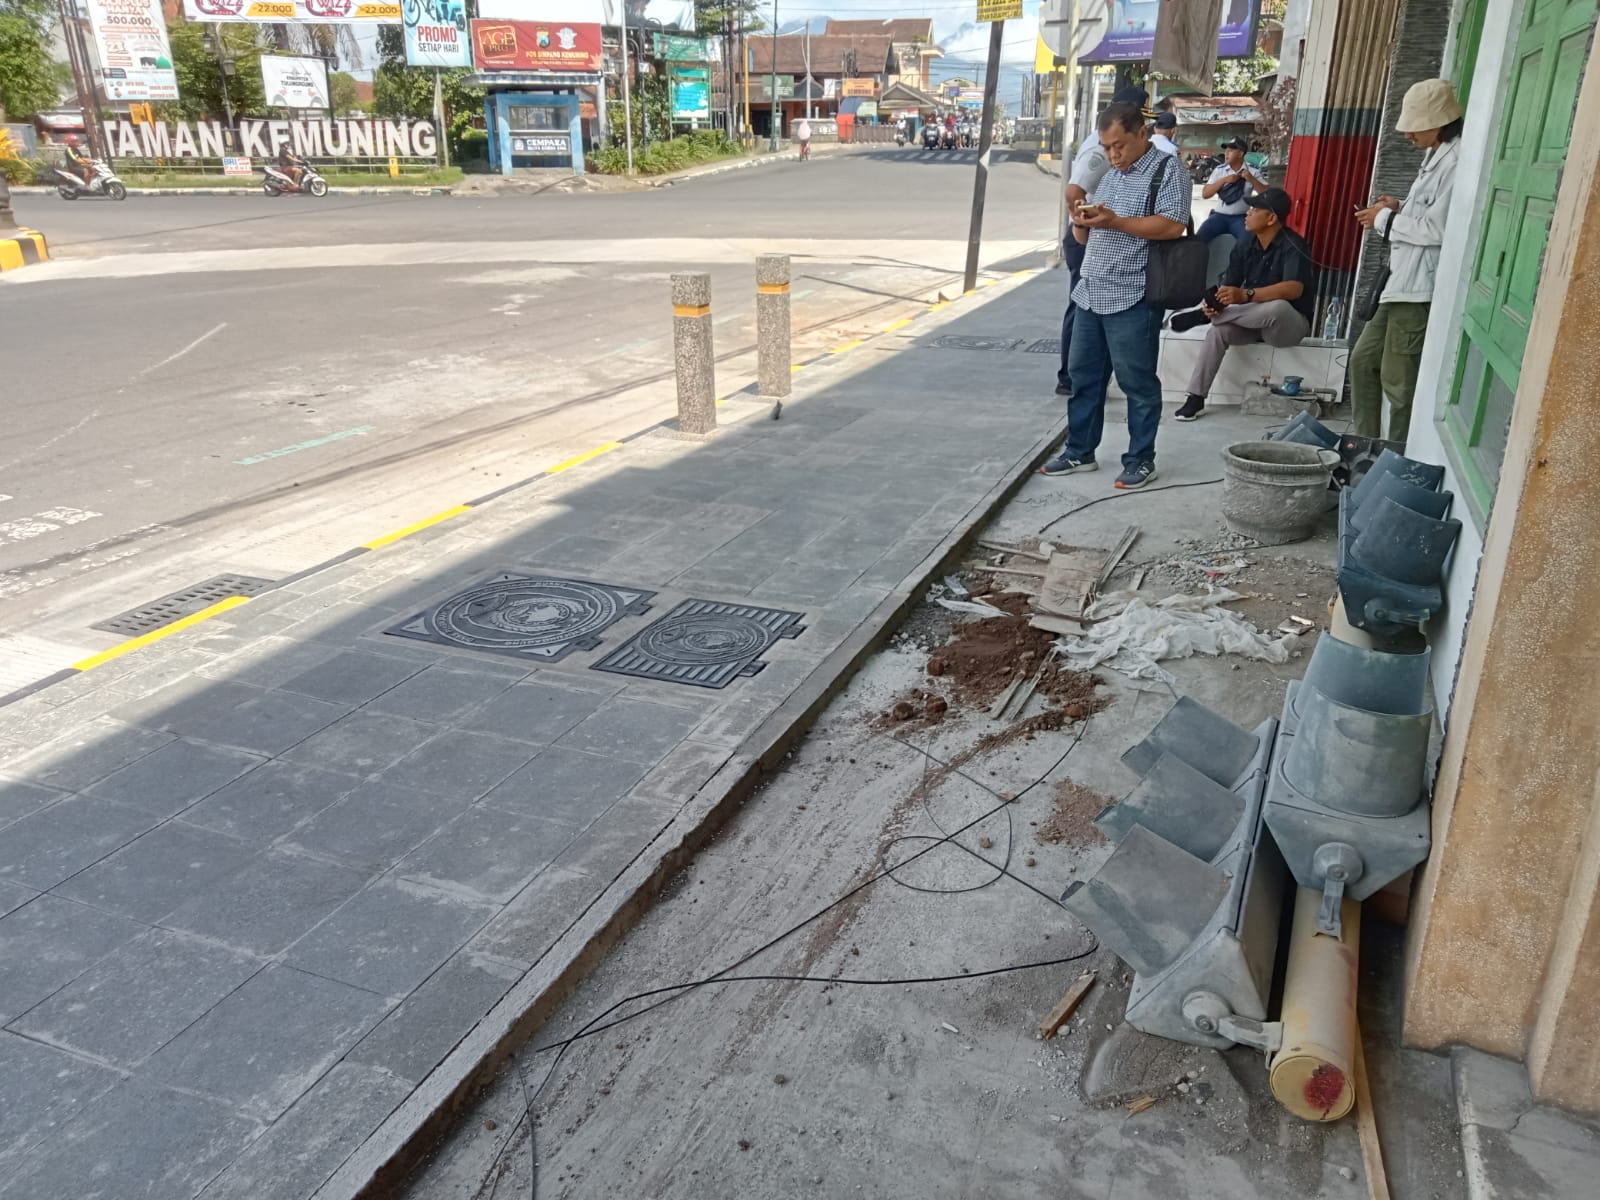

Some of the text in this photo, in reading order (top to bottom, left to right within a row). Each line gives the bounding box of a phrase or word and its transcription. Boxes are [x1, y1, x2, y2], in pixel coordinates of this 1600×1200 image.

[417, 25, 457, 43] PROMO
[418, 43, 459, 53] SETIAP HARI
[103, 120, 225, 158] TAMAN
